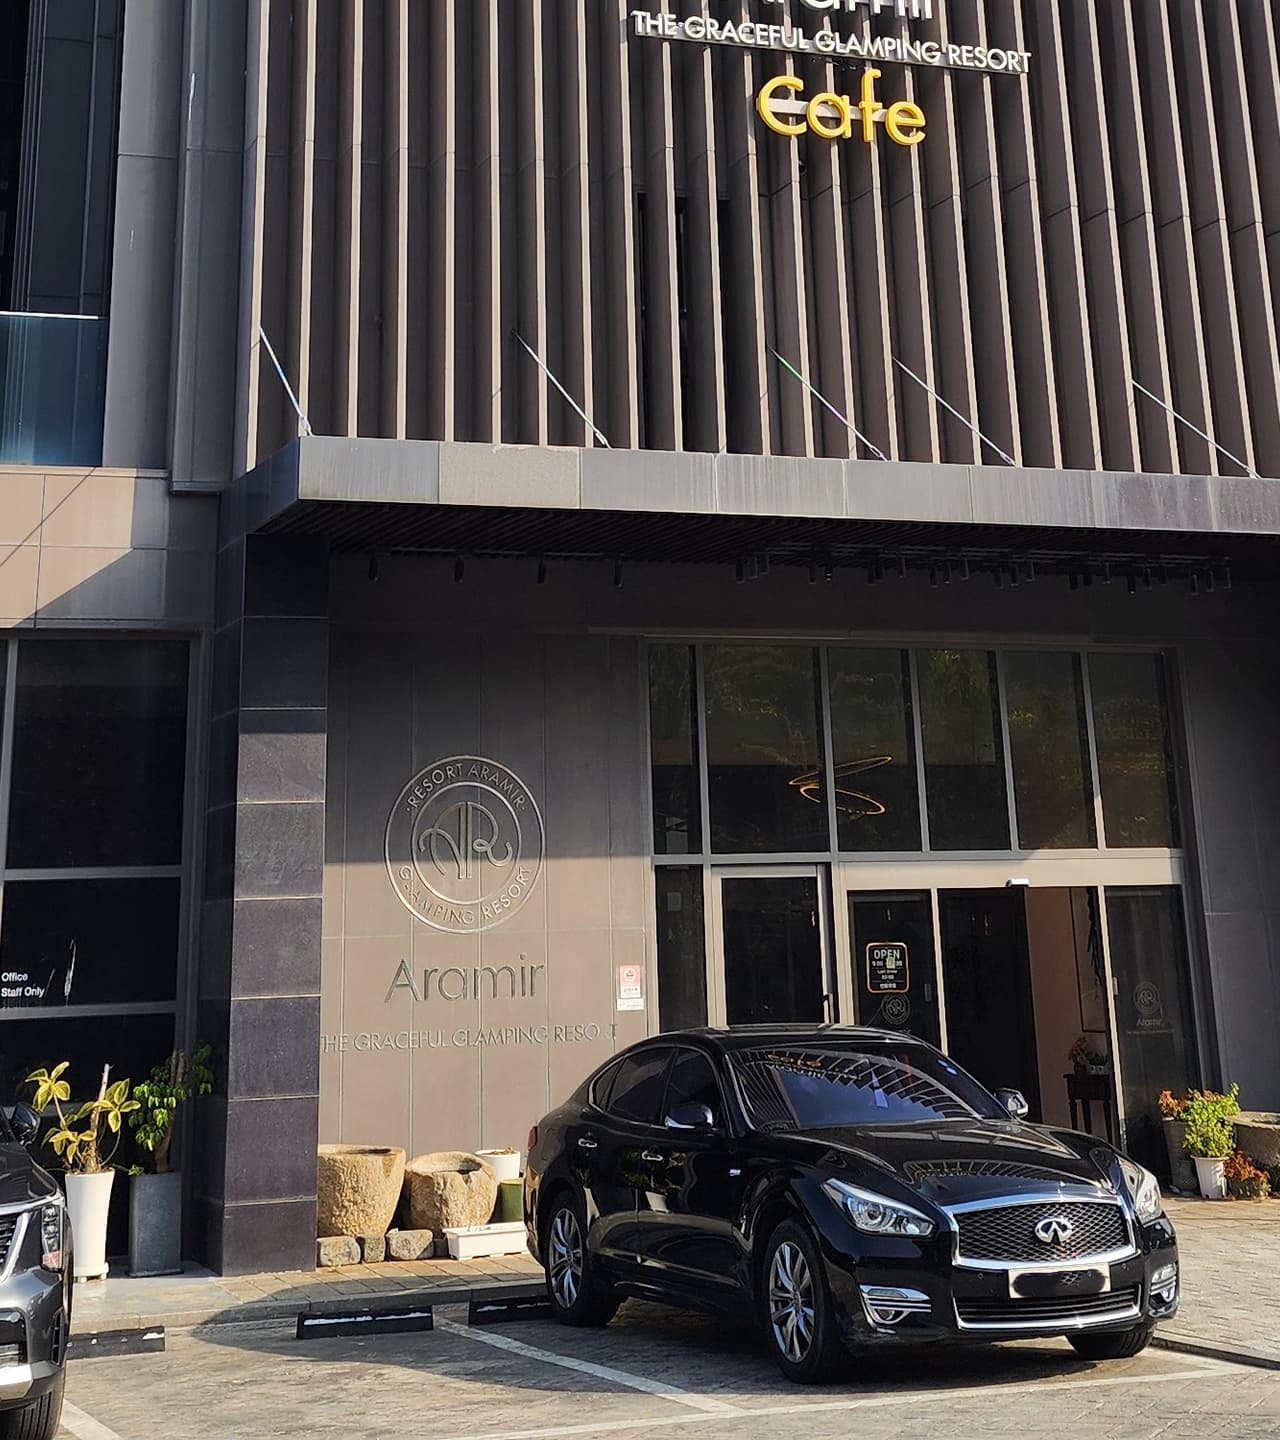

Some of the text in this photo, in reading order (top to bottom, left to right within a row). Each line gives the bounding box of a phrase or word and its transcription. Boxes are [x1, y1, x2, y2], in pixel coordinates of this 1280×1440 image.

[632, 10, 1032, 73] THE GRACEFUL GLAMPING RESORT
[757, 69, 926, 145] Cafe
[407, 764, 526, 809] RESORT ARAMIR
[481, 865, 531, 920] RESORT
[873, 949, 900, 959] OPEN
[1, 972, 28, 982] Office
[1, 986, 45, 998] Staff Only
[384, 953, 545, 1003] Aramir
[353, 1030, 447, 1052] GRACEFUL
[451, 1024, 548, 1047] GLAMPING
